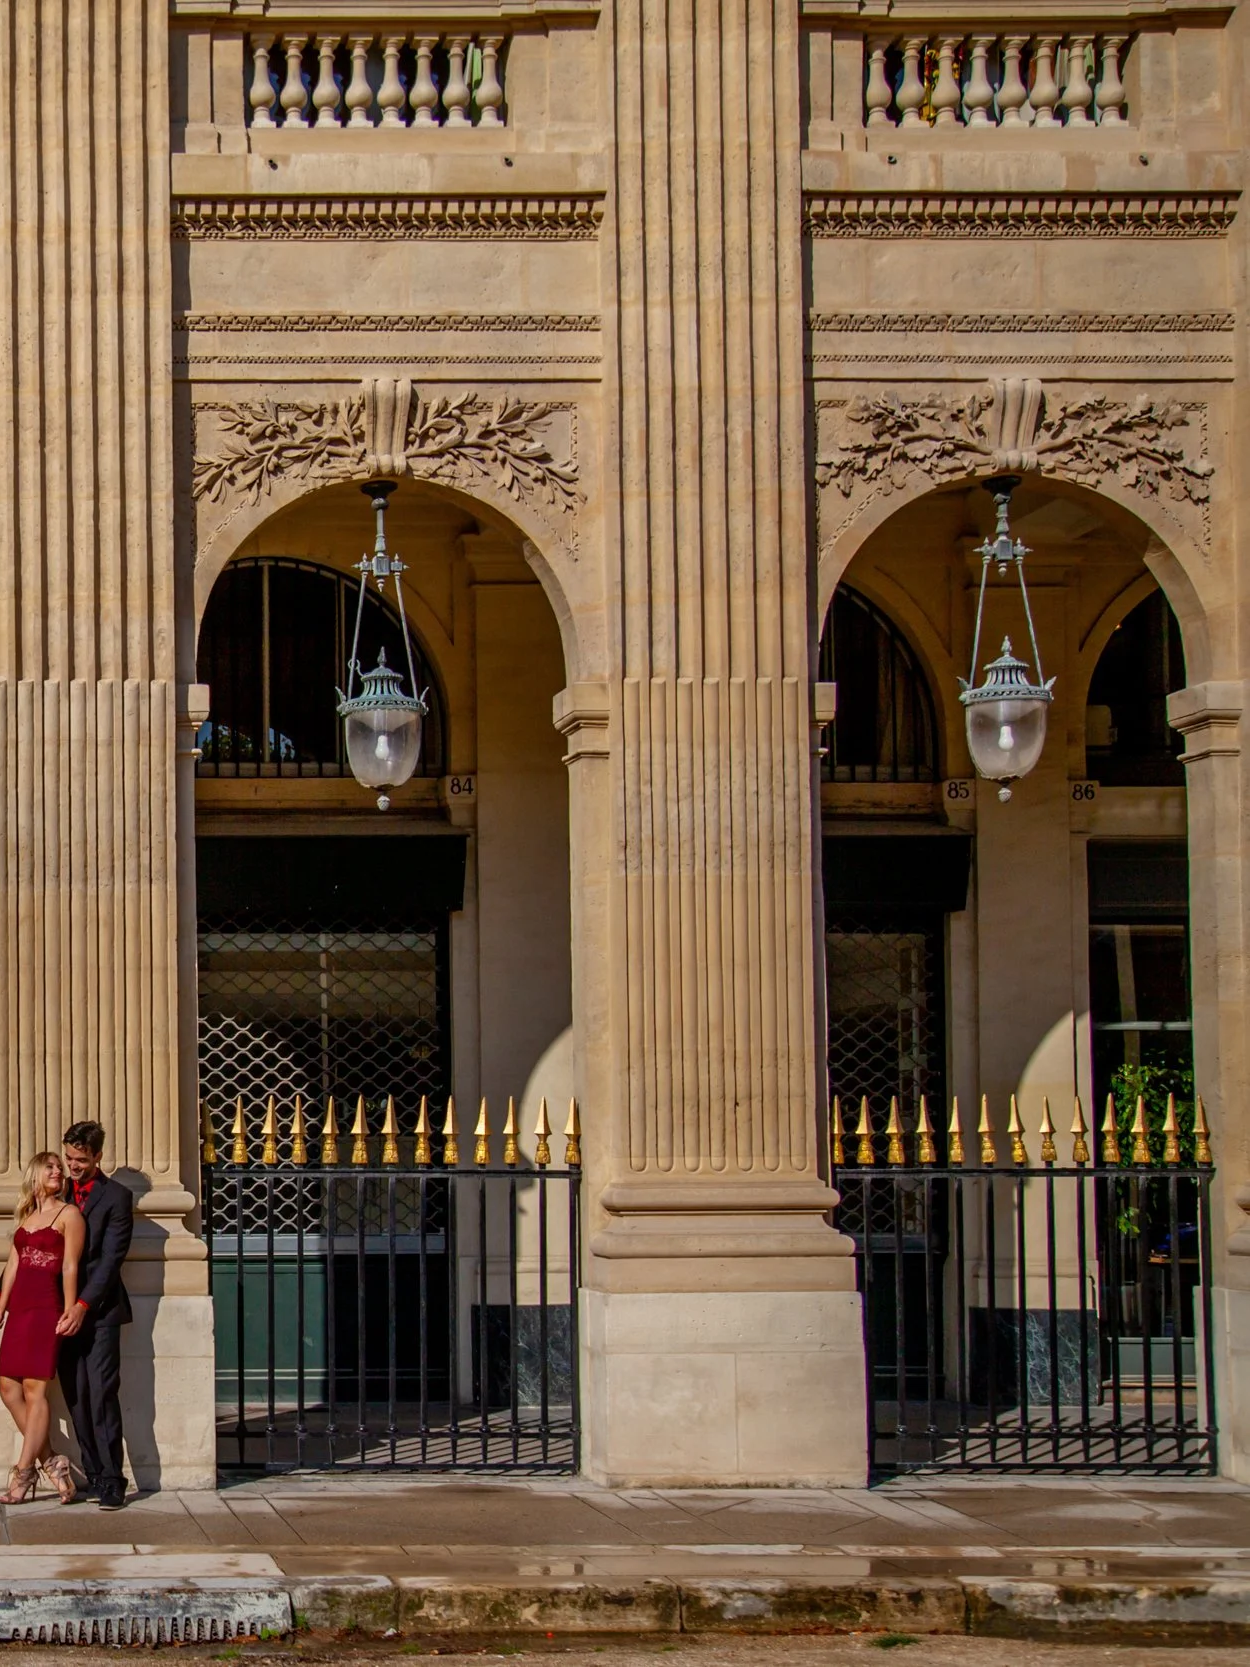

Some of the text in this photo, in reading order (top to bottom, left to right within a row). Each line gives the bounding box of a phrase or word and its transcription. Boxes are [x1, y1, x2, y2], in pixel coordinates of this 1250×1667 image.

[450, 776, 474, 795] 84
[947, 781, 970, 799] 85
[1072, 783, 1095, 801] 86
